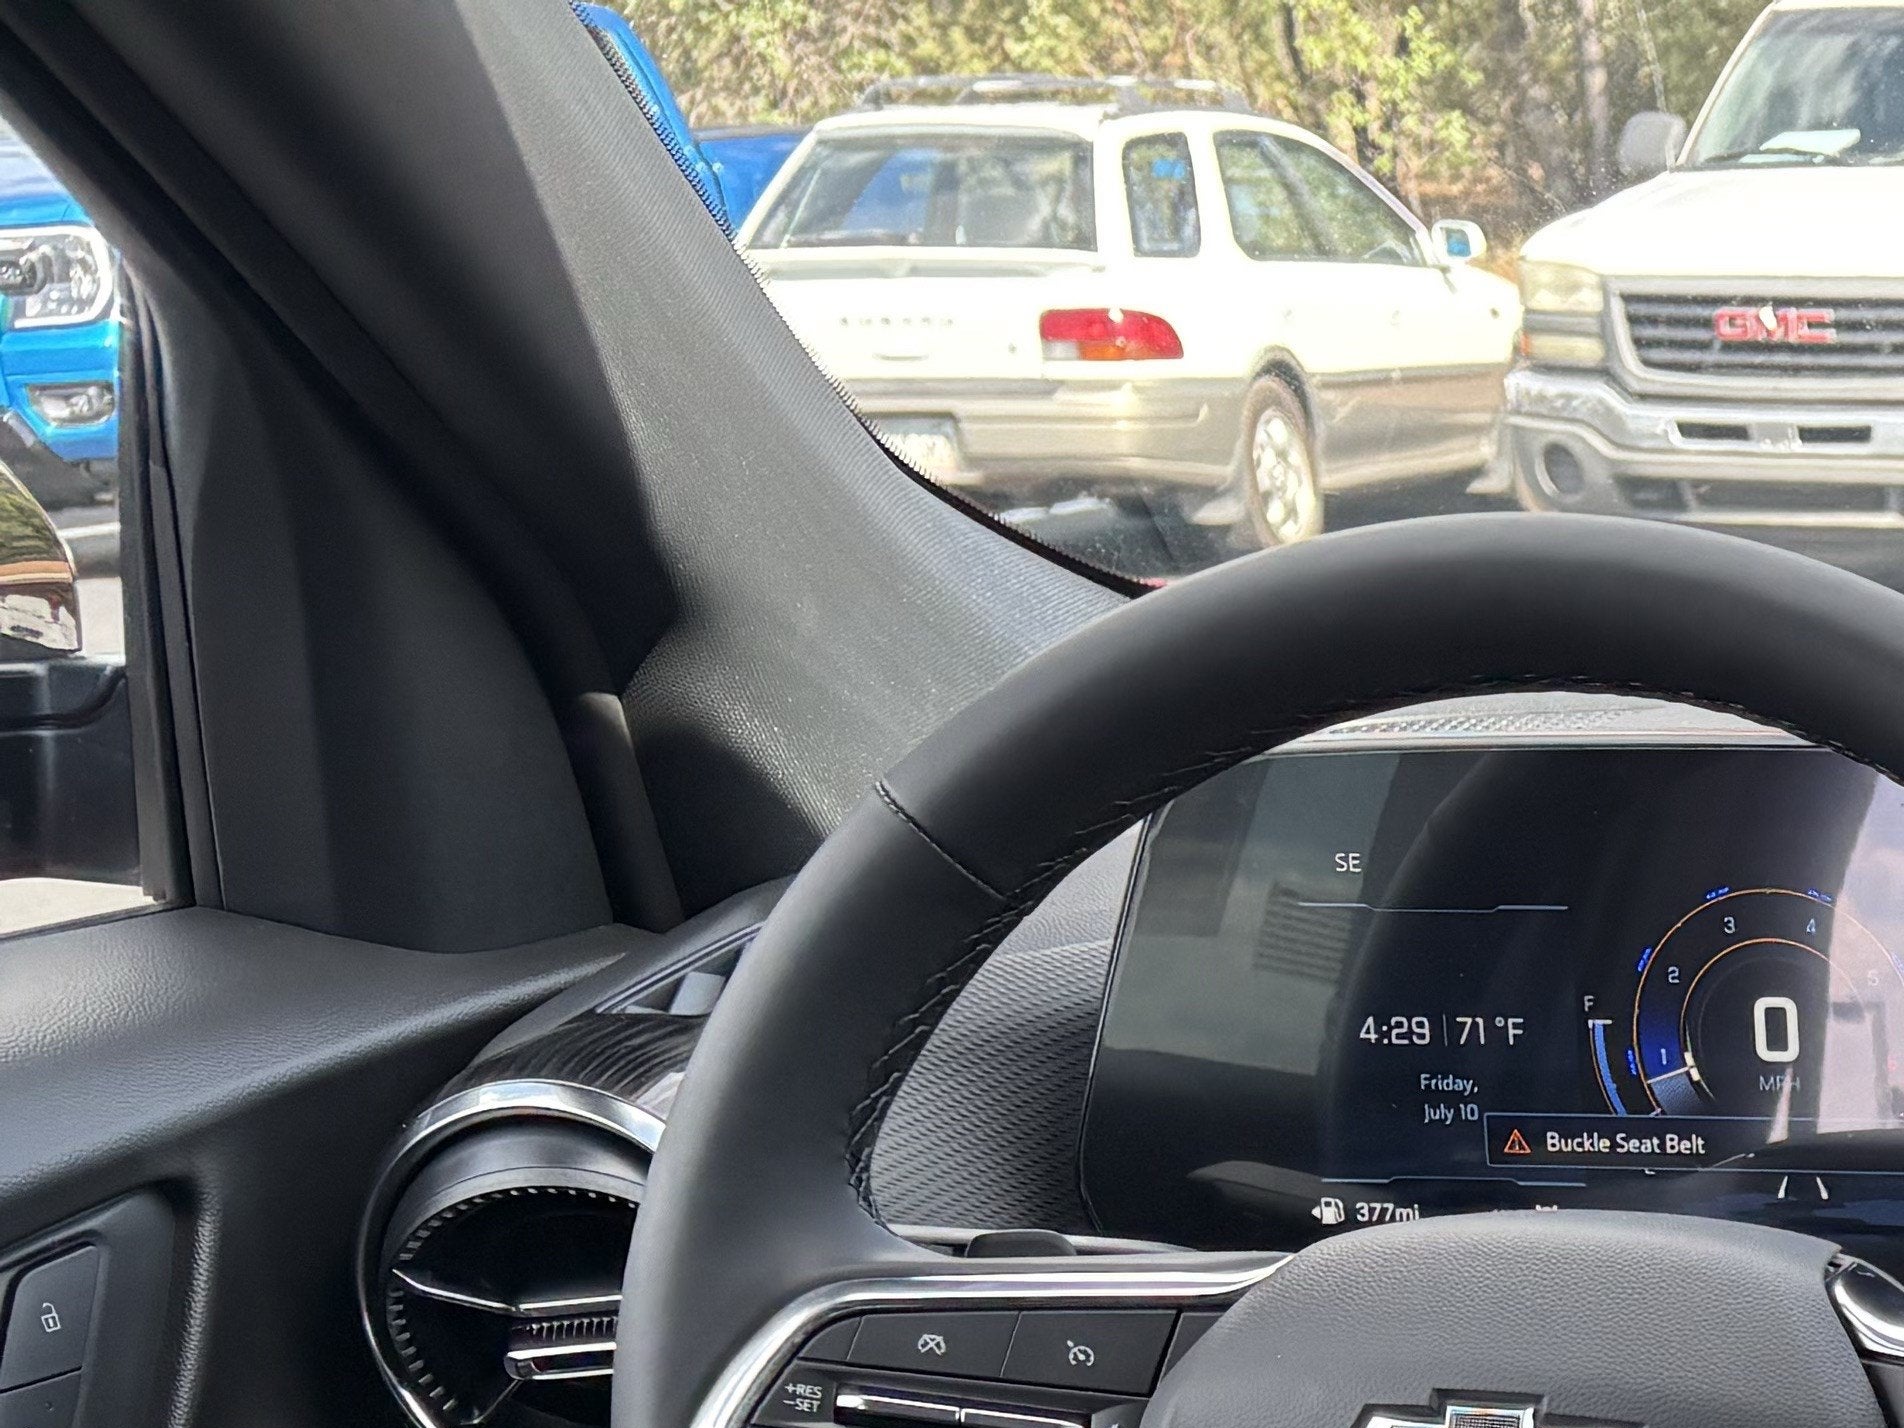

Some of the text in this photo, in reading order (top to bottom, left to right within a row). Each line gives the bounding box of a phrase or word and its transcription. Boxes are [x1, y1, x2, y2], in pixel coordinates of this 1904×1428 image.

[1713, 306, 1837, 344] GMC
[1335, 853, 1362, 872] SE
[1724, 917, 1735, 933] 3
[1806, 918, 1817, 934] 4
[1668, 967, 1680, 984] 2
[1584, 996, 1594, 1012] F
[1359, 1016, 1430, 1045] 4:29
[1753, 997, 1800, 1063] 0
[1420, 1074, 1479, 1095] Friday,
[1424, 1103, 1479, 1124] July 10
[1546, 1132, 1705, 1155] Buckle Seat Belt
